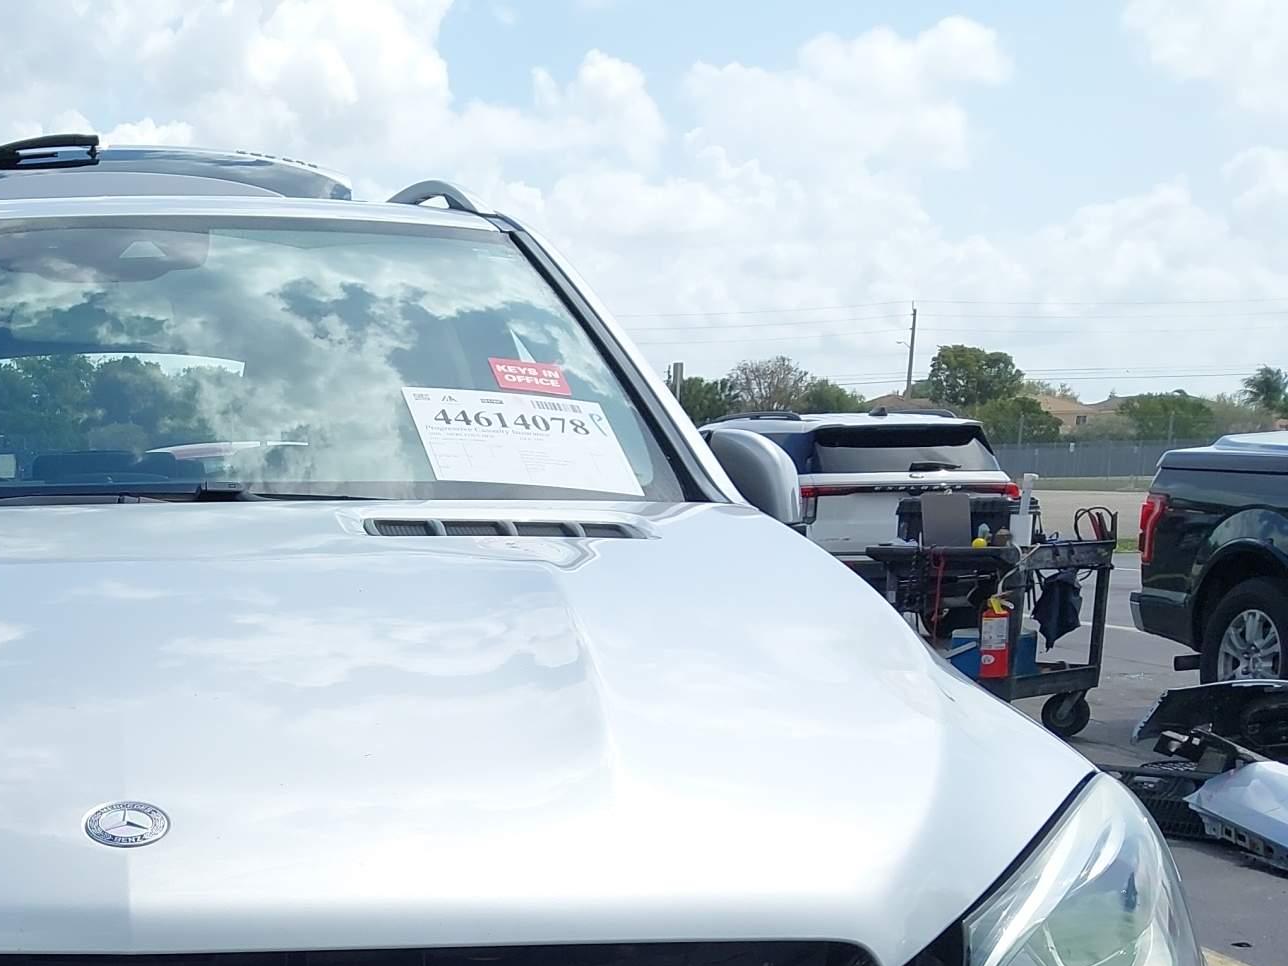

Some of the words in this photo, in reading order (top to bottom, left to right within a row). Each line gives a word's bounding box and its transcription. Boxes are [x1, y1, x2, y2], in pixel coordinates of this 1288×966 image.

[495, 364, 539, 376] KEYS
[541, 368, 561, 379] IN
[503, 374, 561, 388] OFFICE
[433, 408, 590, 436] 44614078
